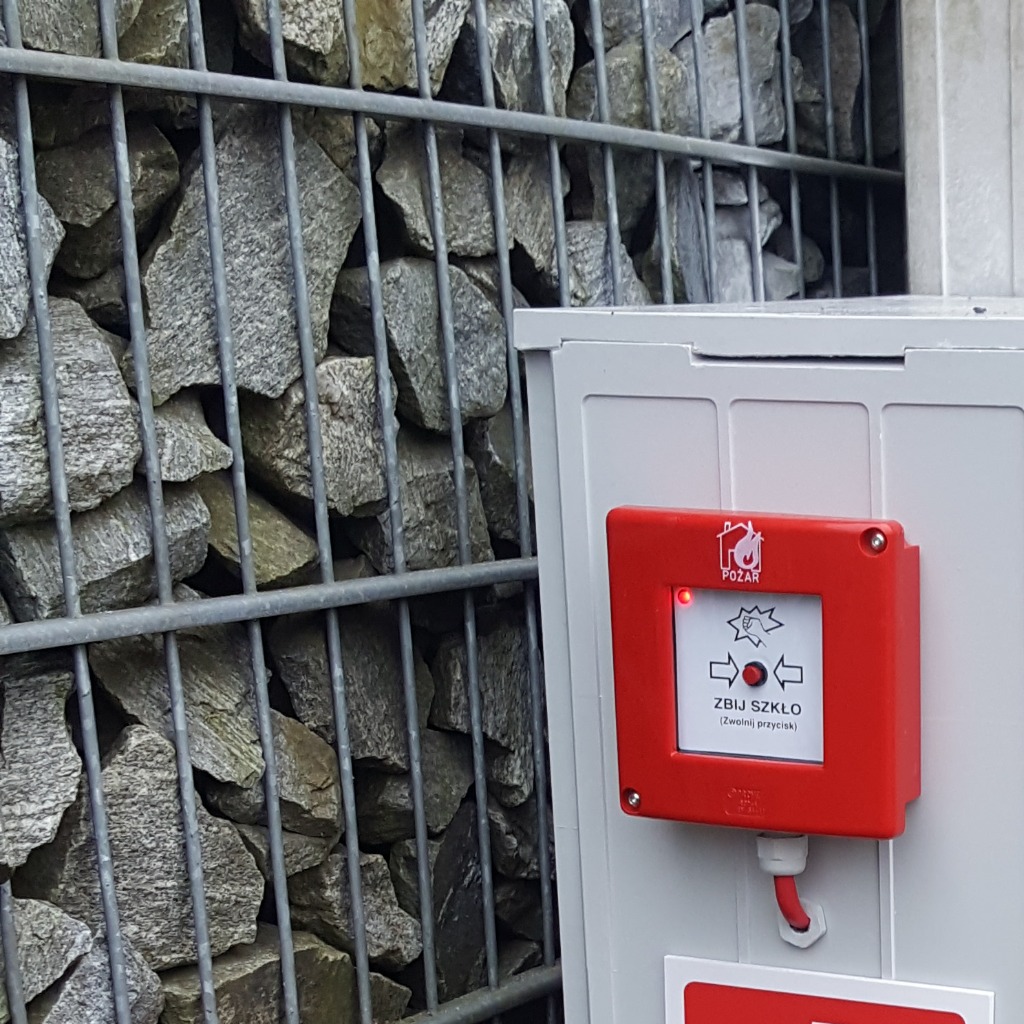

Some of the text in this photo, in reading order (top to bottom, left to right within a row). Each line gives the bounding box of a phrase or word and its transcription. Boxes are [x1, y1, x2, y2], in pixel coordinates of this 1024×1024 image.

[722, 568, 760, 584] POŻAR
[714, 697, 802, 715] ZBIJ SZKŁO
[720, 716, 798, 732] (Zwolnij przycisk)
